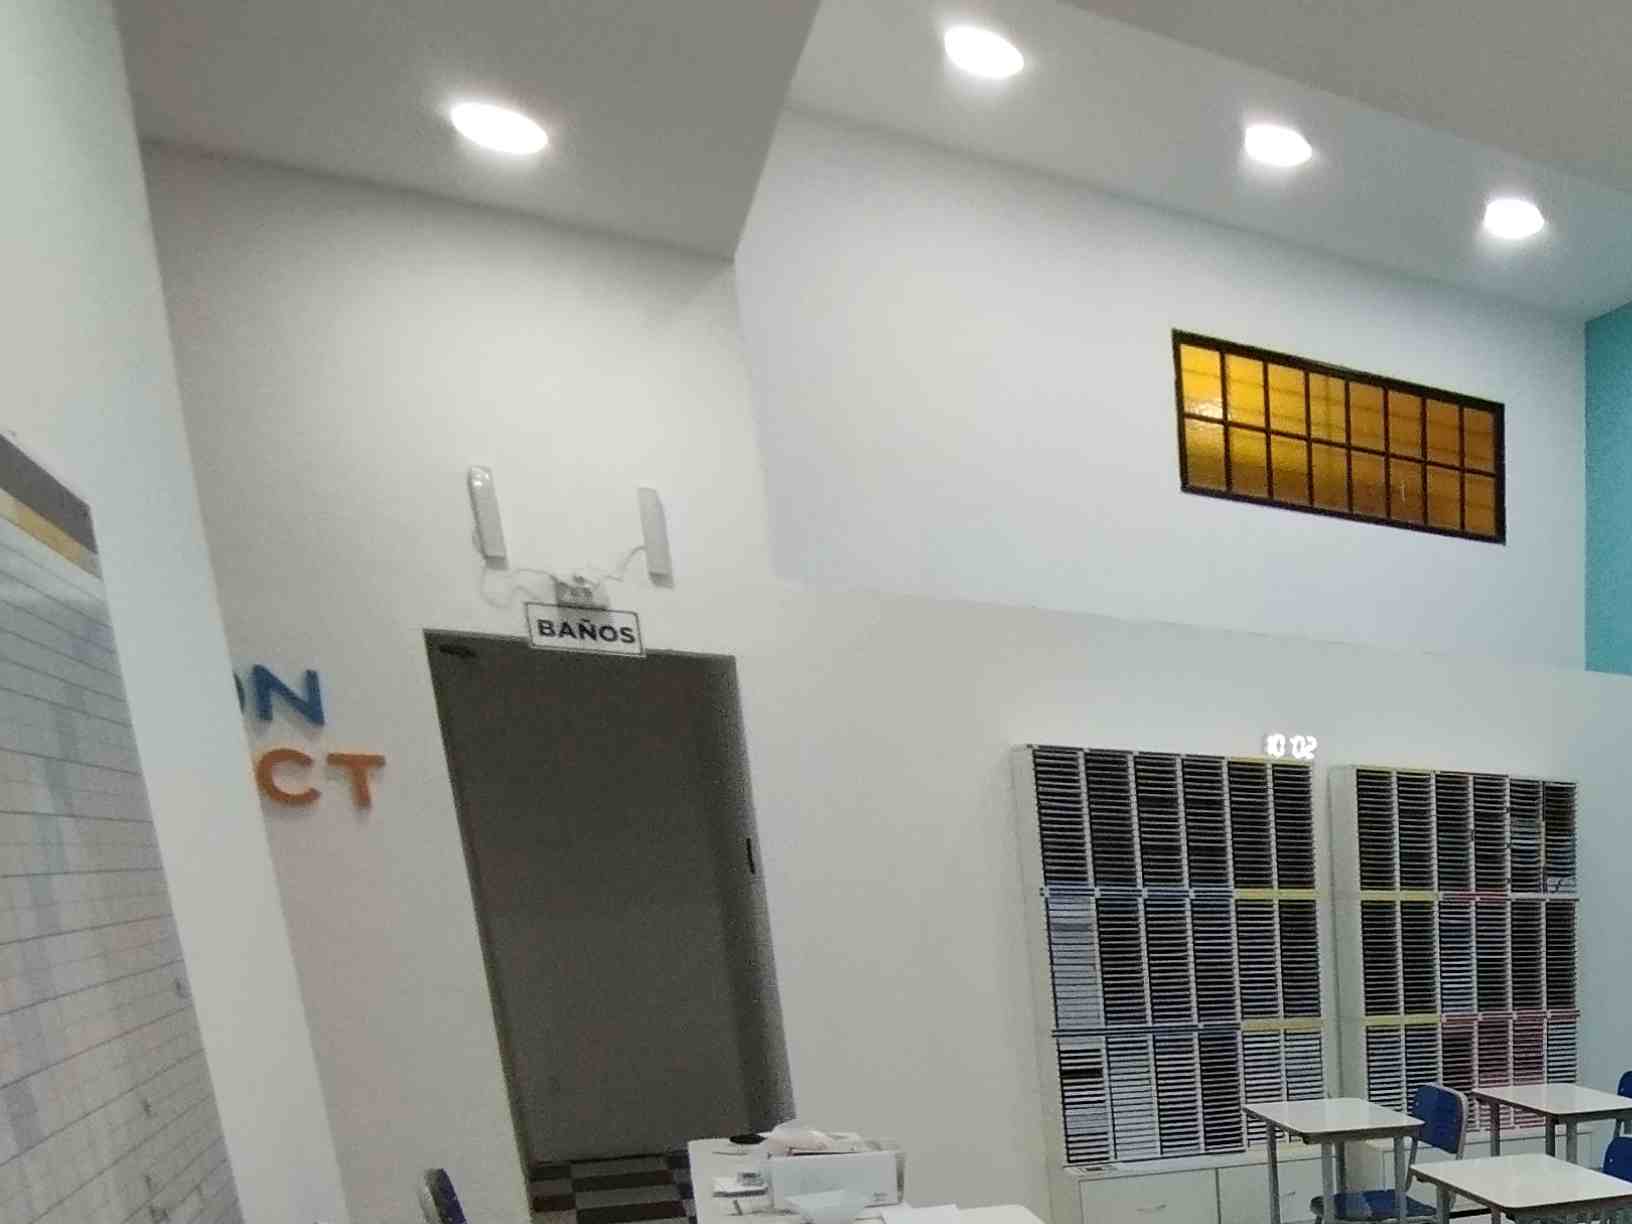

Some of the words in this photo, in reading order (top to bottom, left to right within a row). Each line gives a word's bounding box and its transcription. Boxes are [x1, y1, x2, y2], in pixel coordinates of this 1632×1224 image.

[536, 618, 636, 644] BAÑOS
[233, 664, 325, 726] N
[255, 748, 387, 808] CT
